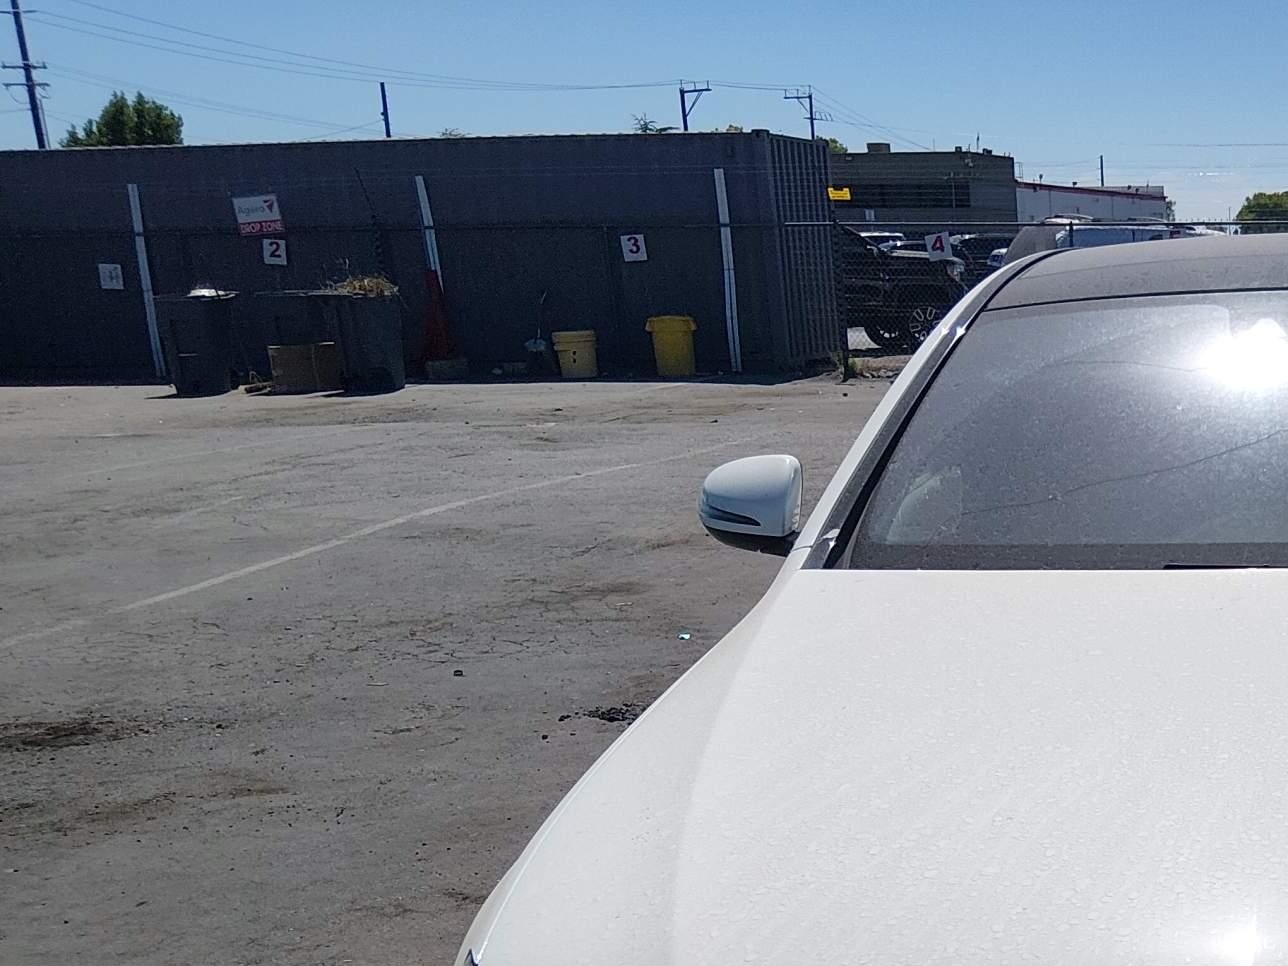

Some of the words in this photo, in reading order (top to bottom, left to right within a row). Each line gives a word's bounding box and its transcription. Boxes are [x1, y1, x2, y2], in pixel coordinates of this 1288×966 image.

[268, 241, 282, 258] 2
[627, 236, 641, 254] 3
[931, 235, 945, 253] 4
